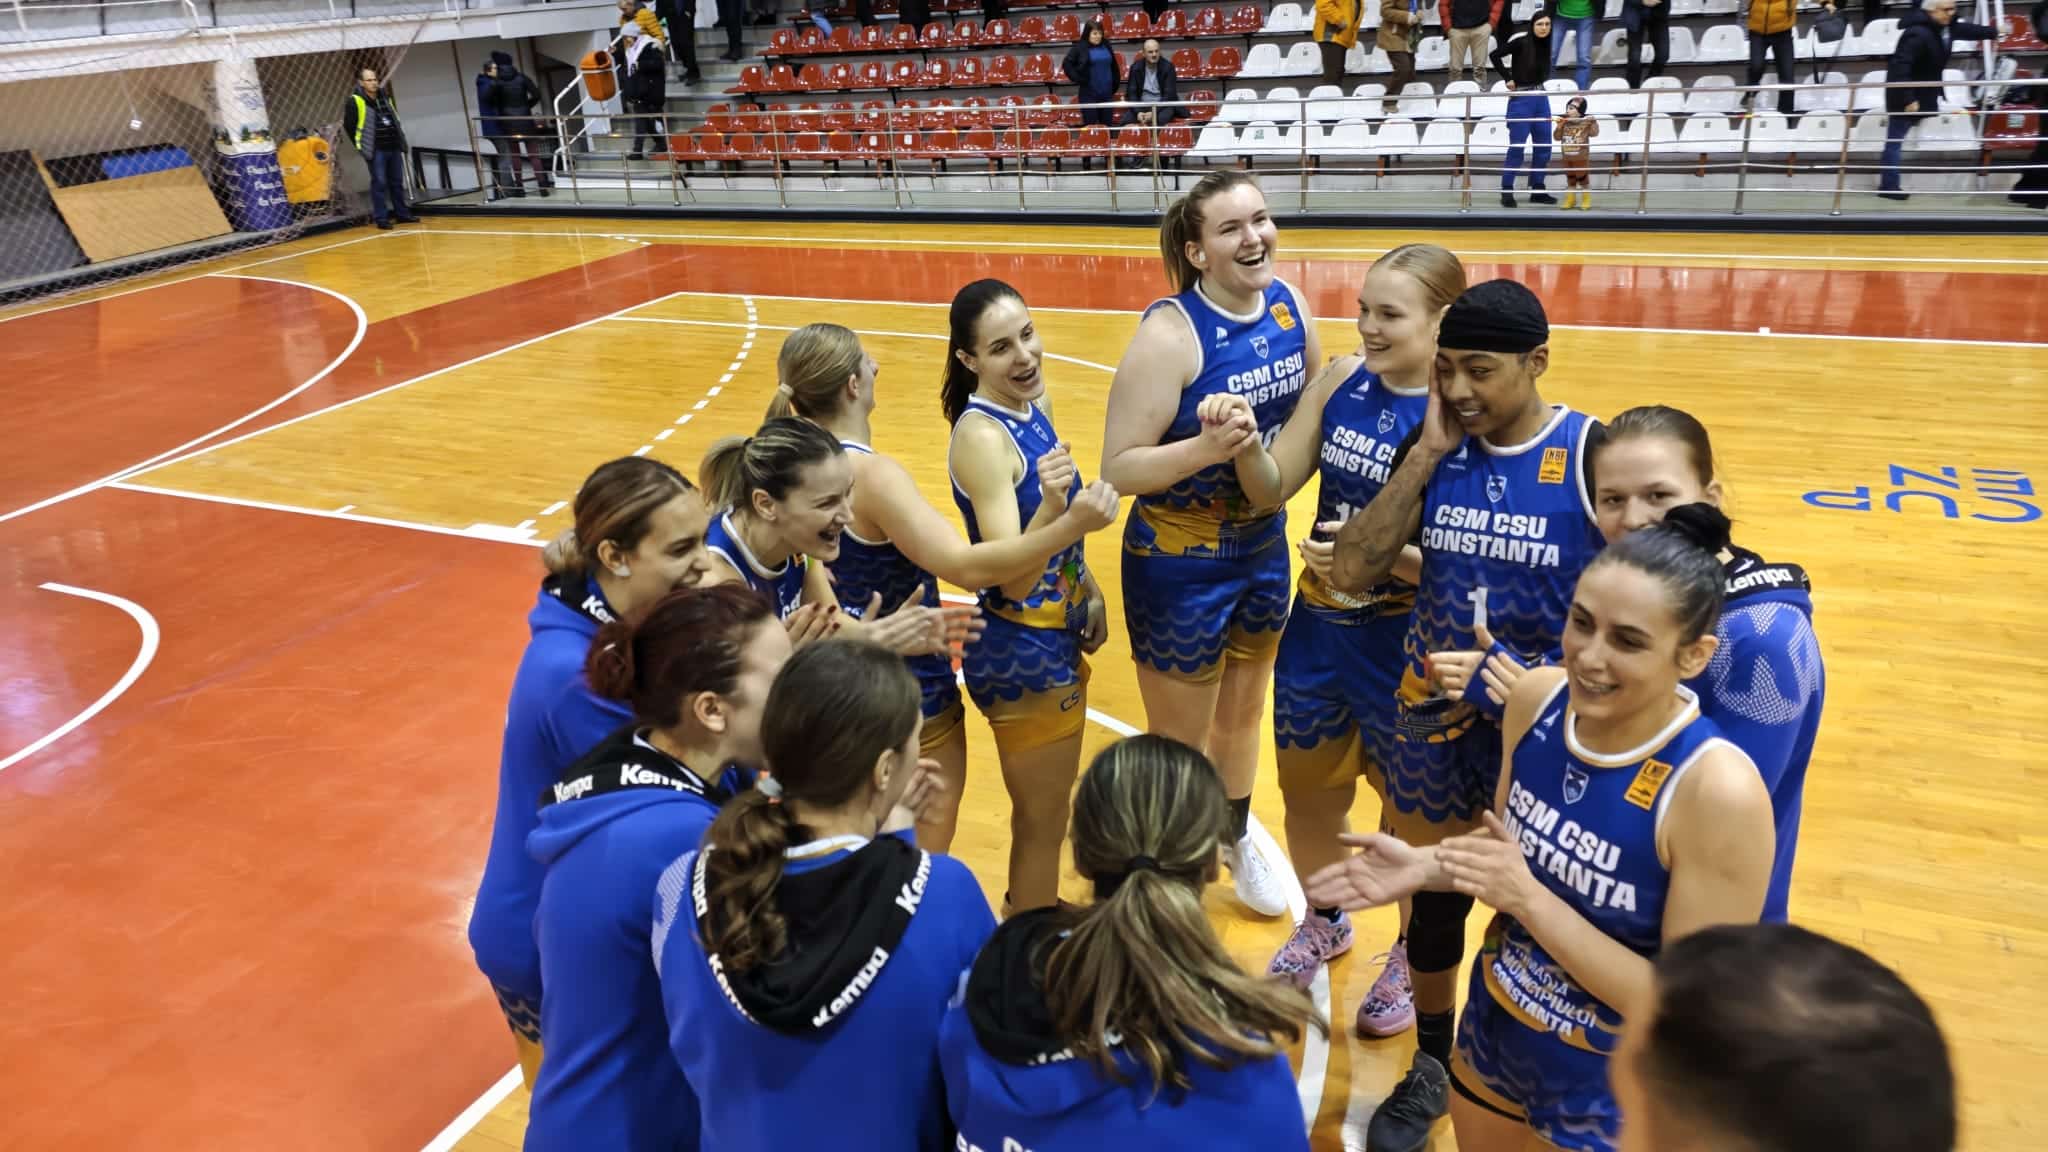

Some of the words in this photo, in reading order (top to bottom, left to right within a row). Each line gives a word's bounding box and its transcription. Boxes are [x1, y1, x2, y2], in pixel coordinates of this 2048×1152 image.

[1227, 365, 1272, 393] CSM
[1273, 352, 1303, 379] CSU
[1332, 425, 1376, 456] CSM
[1434, 504, 1490, 531] CSM
[1493, 513, 1548, 539] CSU
[1421, 527, 1560, 568] CONSTANȚA
[1467, 586, 1489, 628] 1
[553, 774, 594, 804] Kempa
[1509, 780, 1560, 837] CSM
[1557, 820, 1622, 872] CSU
